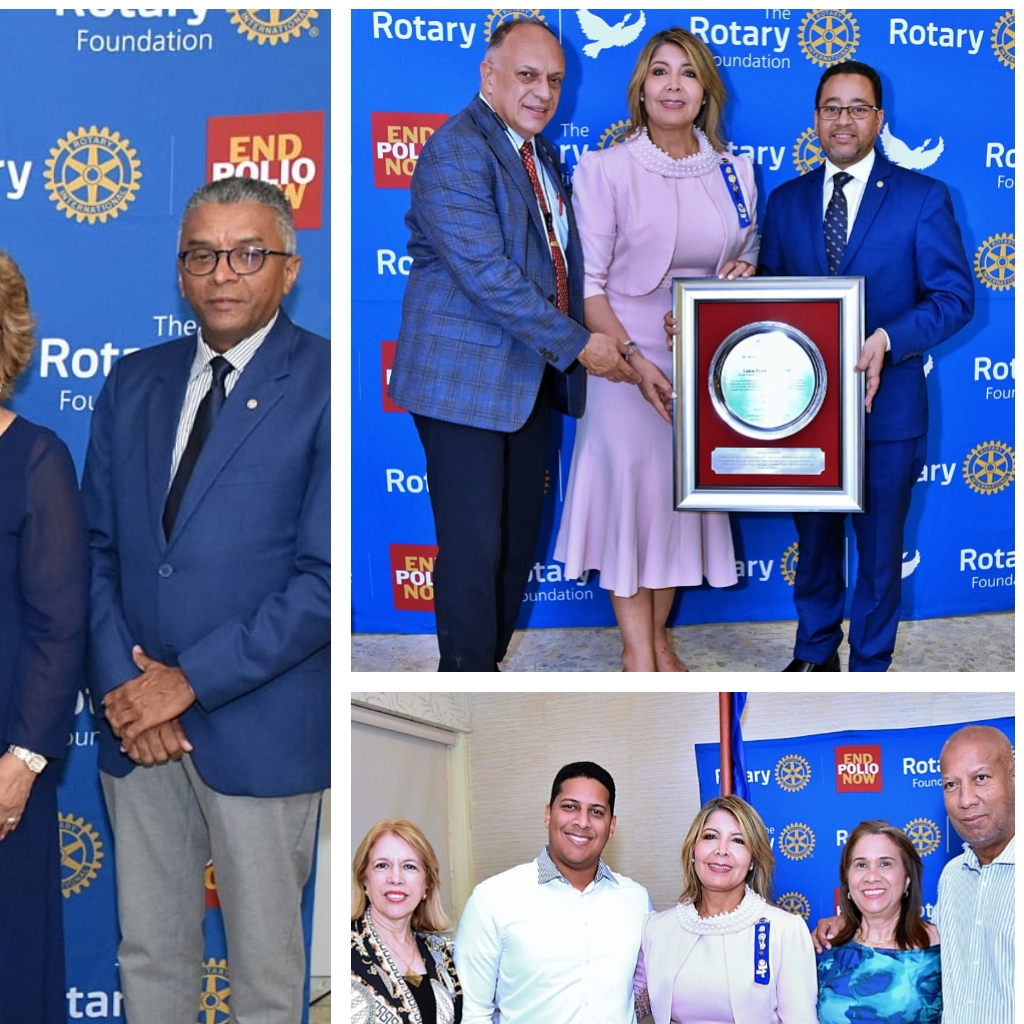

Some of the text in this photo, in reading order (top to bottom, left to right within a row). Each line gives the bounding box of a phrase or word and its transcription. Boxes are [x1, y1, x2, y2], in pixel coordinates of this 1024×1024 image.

[372, 11, 476, 49] Rotary
[690, 16, 791, 52] Rotary
[889, 18, 984, 54] Rotary
[77, 29, 213, 51] Foundation
[713, 54, 791, 68] oundation
[560, 123, 589, 137] The
[73, 136, 113, 148] ROTARY
[230, 133, 302, 164] END
[59, 189, 126, 214] INTERNATIONAL
[153, 315, 196, 337] The
[523, 588, 593, 602] oundation
[843, 753, 872, 765] END
[838, 763, 879, 775] POLIO
[842, 773, 875, 785] NOW
